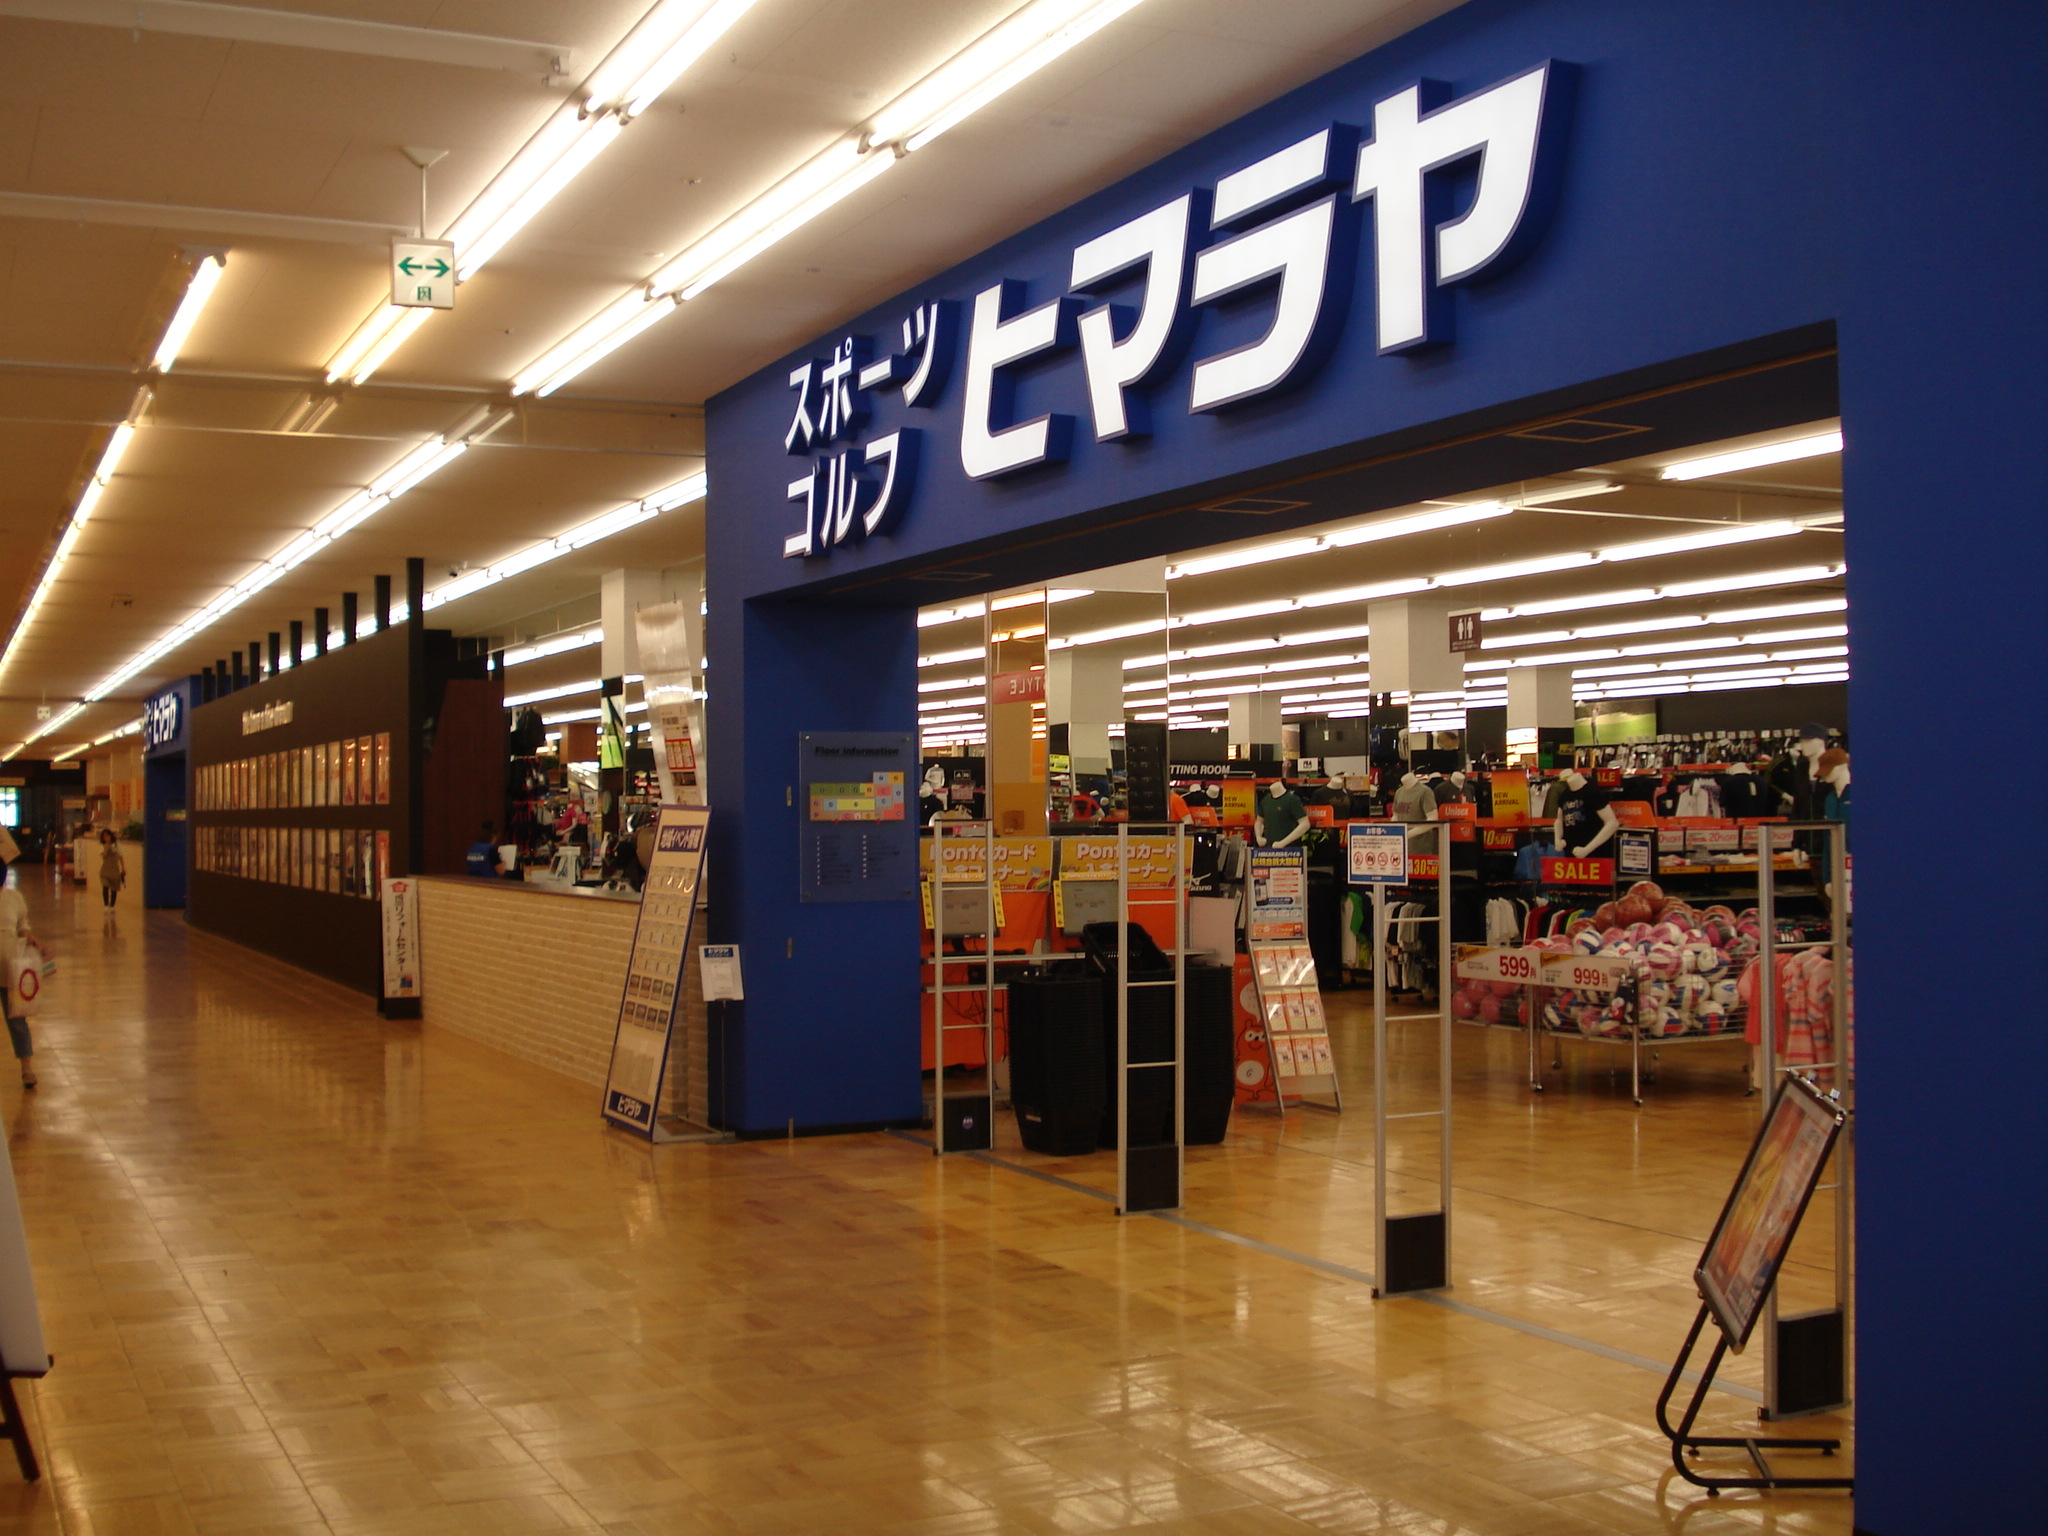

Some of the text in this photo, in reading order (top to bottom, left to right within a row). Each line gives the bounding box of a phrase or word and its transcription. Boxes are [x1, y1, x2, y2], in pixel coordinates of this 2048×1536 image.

[961, 58, 1554, 482] ヒマラヤ
[784, 299, 941, 454] スポーツ
[783, 428, 900, 558] ゴルフ
[815, 746, 899, 756] Floor information
[1200, 765, 1231, 775] ROOM
[1445, 805, 1469, 817] Unisex
[1554, 862, 1601, 880] SALE
[1500, 955, 1530, 978] 599
[1573, 967, 1600, 986] 999
